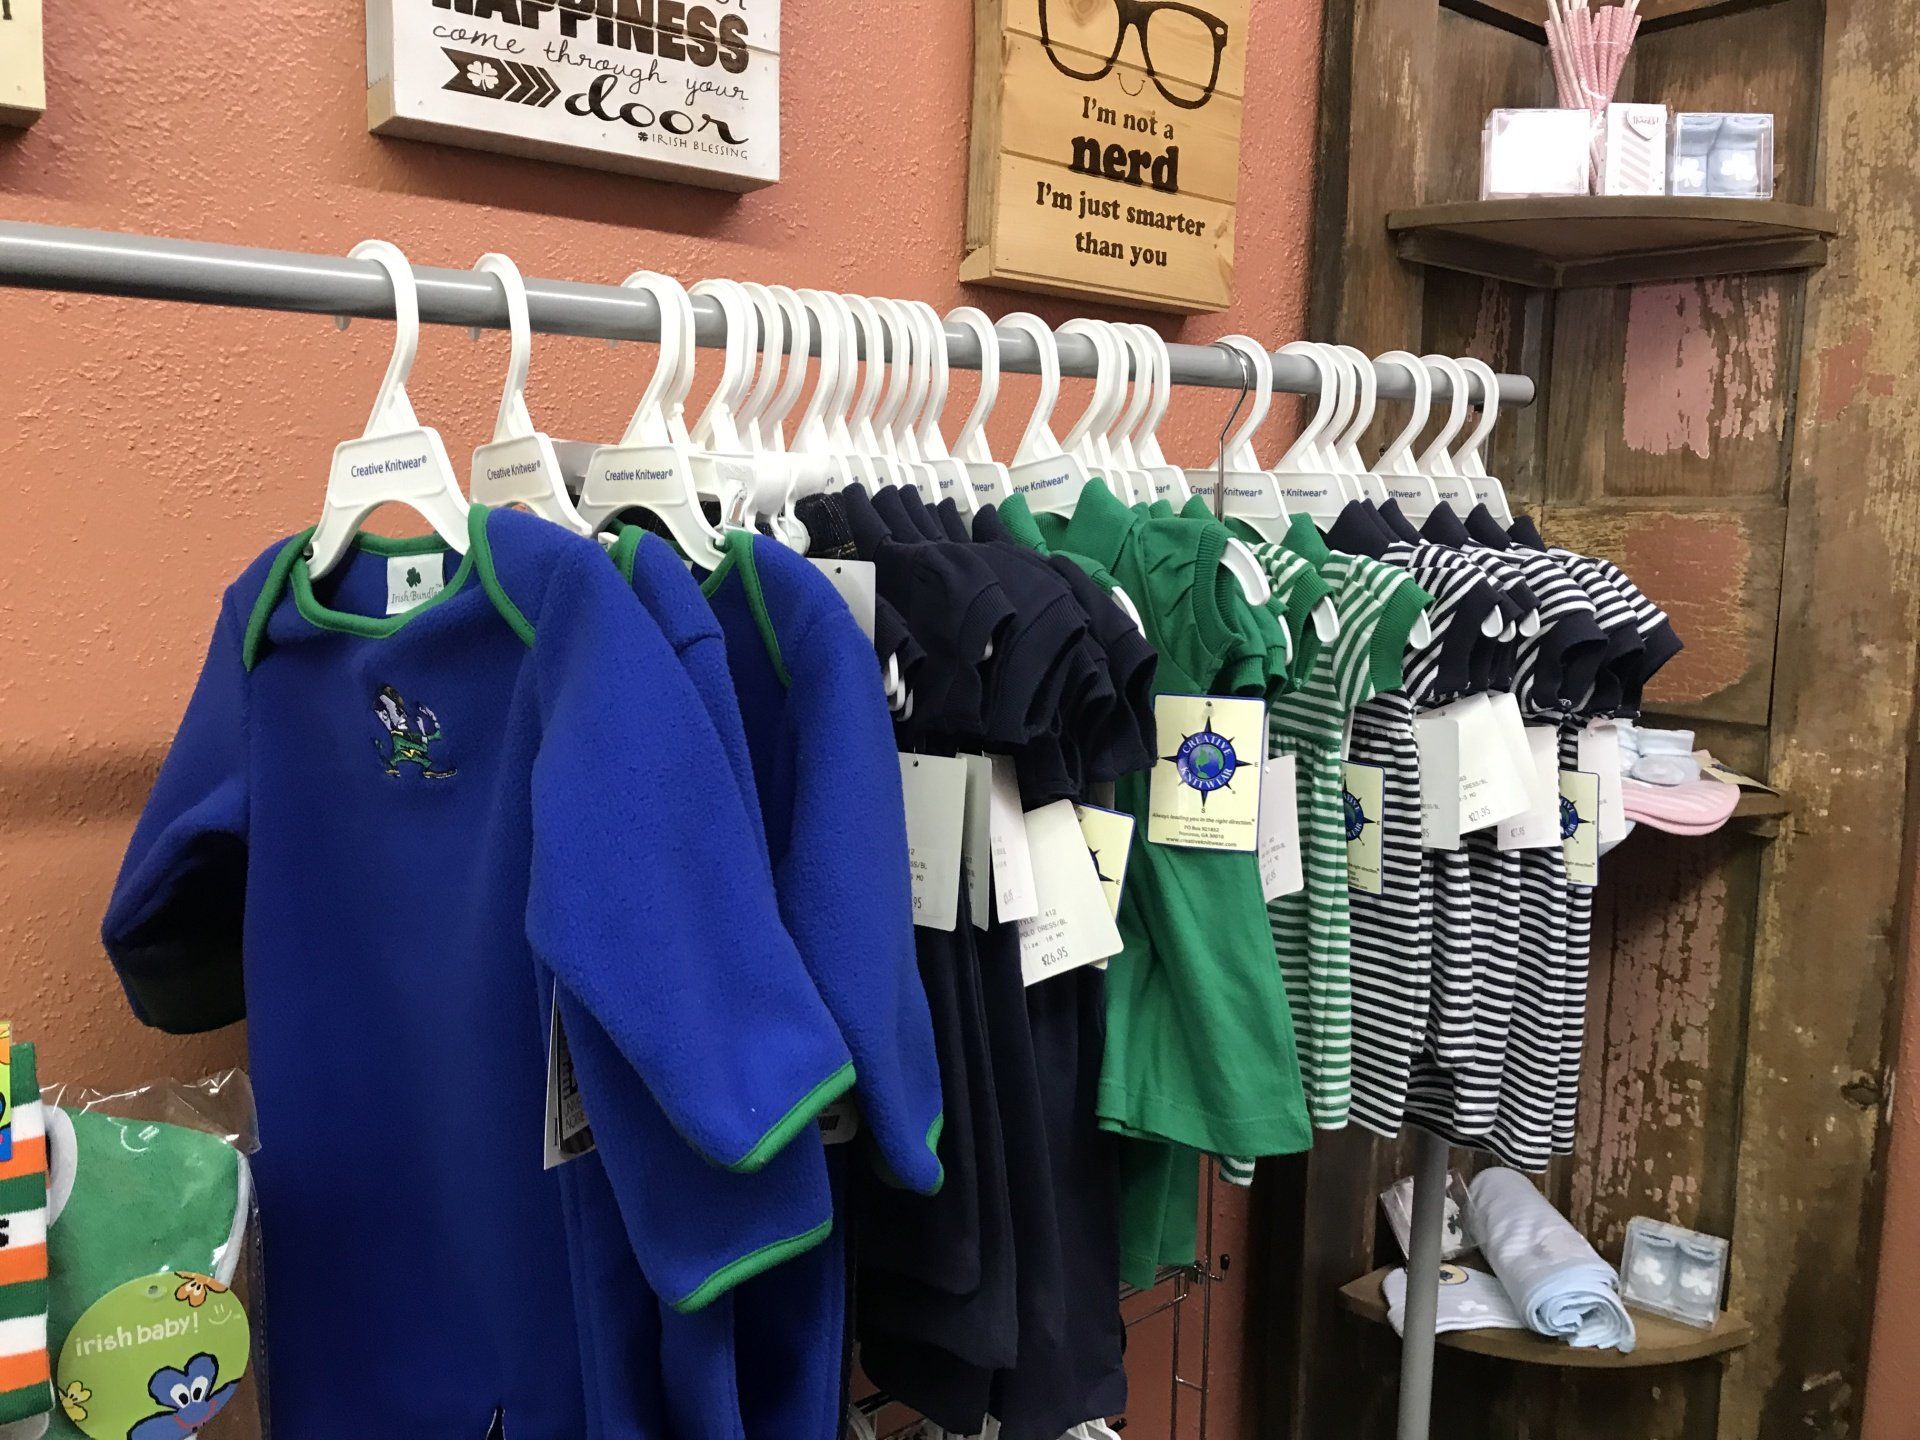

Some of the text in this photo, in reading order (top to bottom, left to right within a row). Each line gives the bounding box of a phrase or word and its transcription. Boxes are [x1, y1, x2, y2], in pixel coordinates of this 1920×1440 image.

[432, 0, 750, 75] PPINESS
[433, 25, 749, 106] come through your
[564, 74, 749, 145] door
[1082, 96, 1174, 140] I'm not a
[652, 134, 749, 160] IRISH BLESSING
[1068, 136, 1179, 193] nerd
[1036, 181, 1206, 236] I'm just smarter
[1075, 232, 1168, 267] than you
[351, 462, 384, 478] Creative
[487, 466, 511, 481] Creative
[604, 469, 634, 481] Creative
[1387, 489, 1421, 498] nitwear®
[391, 590, 409, 604] Irish
[1182, 734, 1233, 756] CREATIVE
[1181, 767, 1233, 789] KNITWEAR
[1468, 806, 1491, 822] $27.95
[1019, 916, 1035, 928] TYLE
[1041, 946, 1069, 967] $26.95
[75, 1312, 199, 1357] irish baby!
